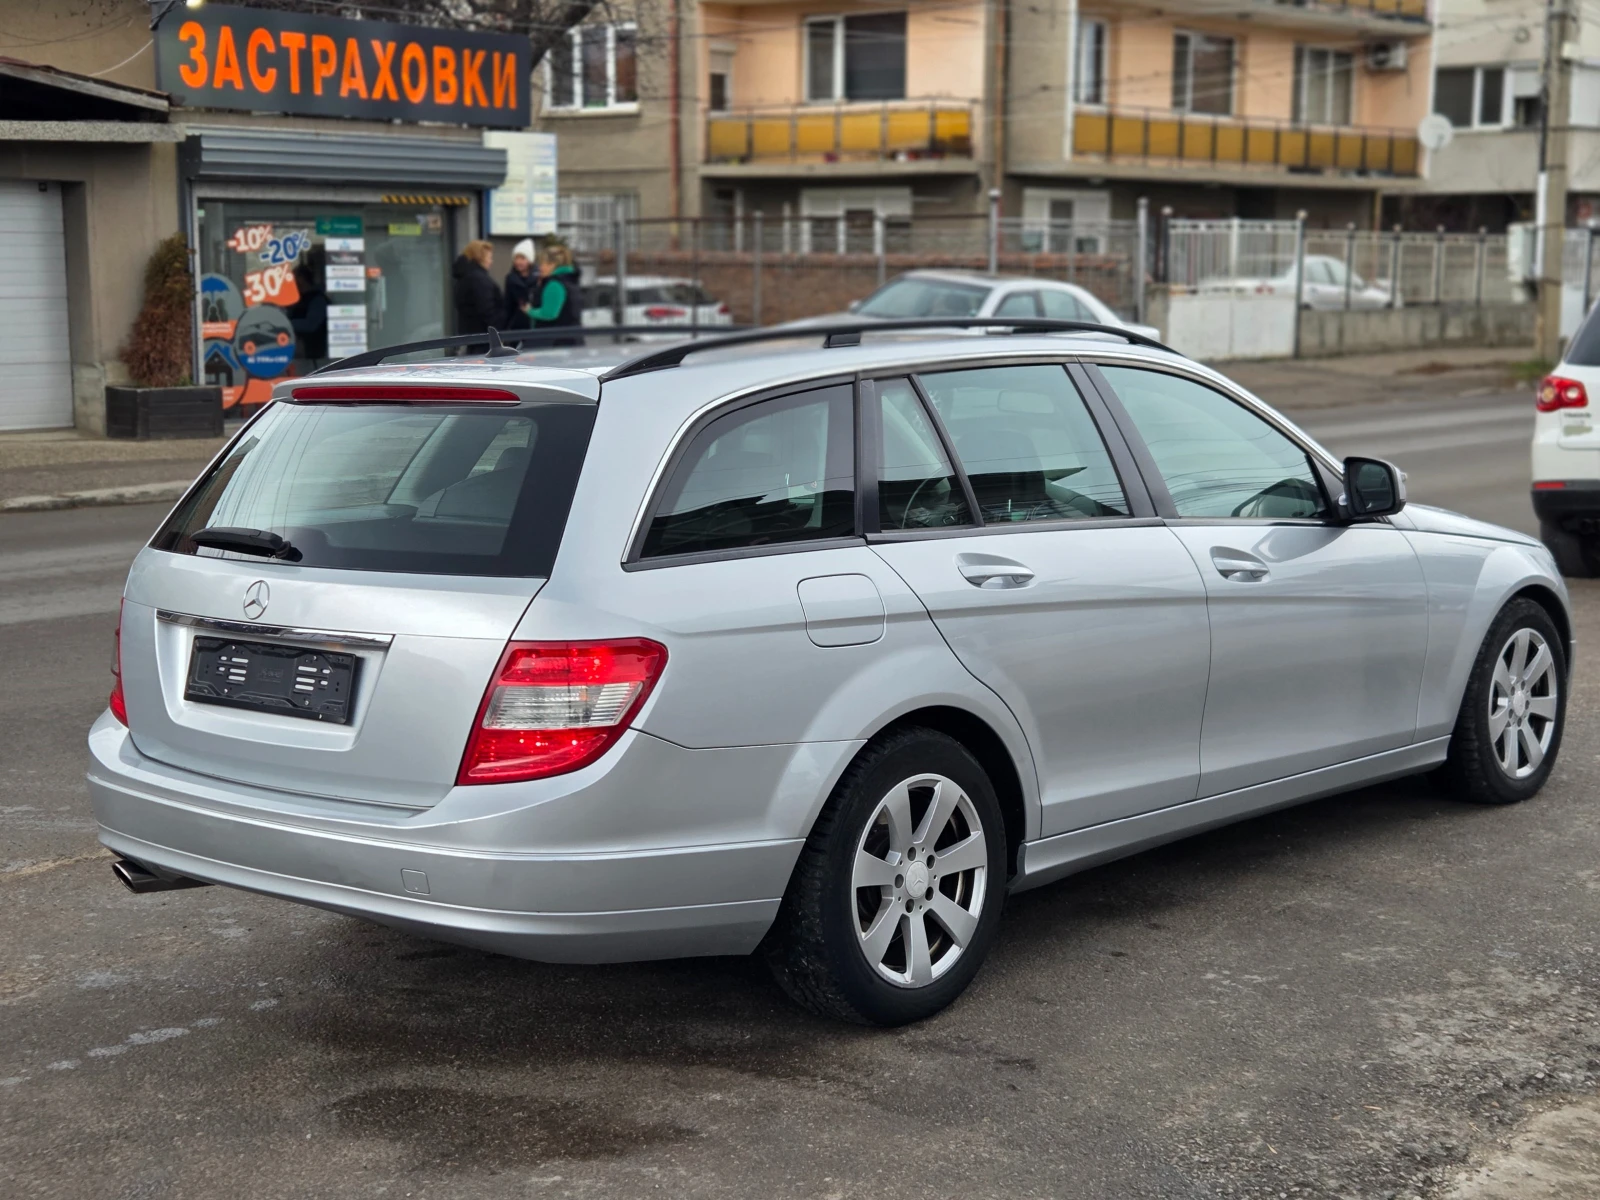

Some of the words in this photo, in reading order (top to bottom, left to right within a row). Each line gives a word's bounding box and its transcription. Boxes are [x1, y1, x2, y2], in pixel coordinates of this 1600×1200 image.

[178, 21, 518, 110] ЗАСТРАХОВКИ
[227, 225, 273, 252] -10%
[260, 230, 309, 264] -20%
[243, 263, 293, 302] -30%
